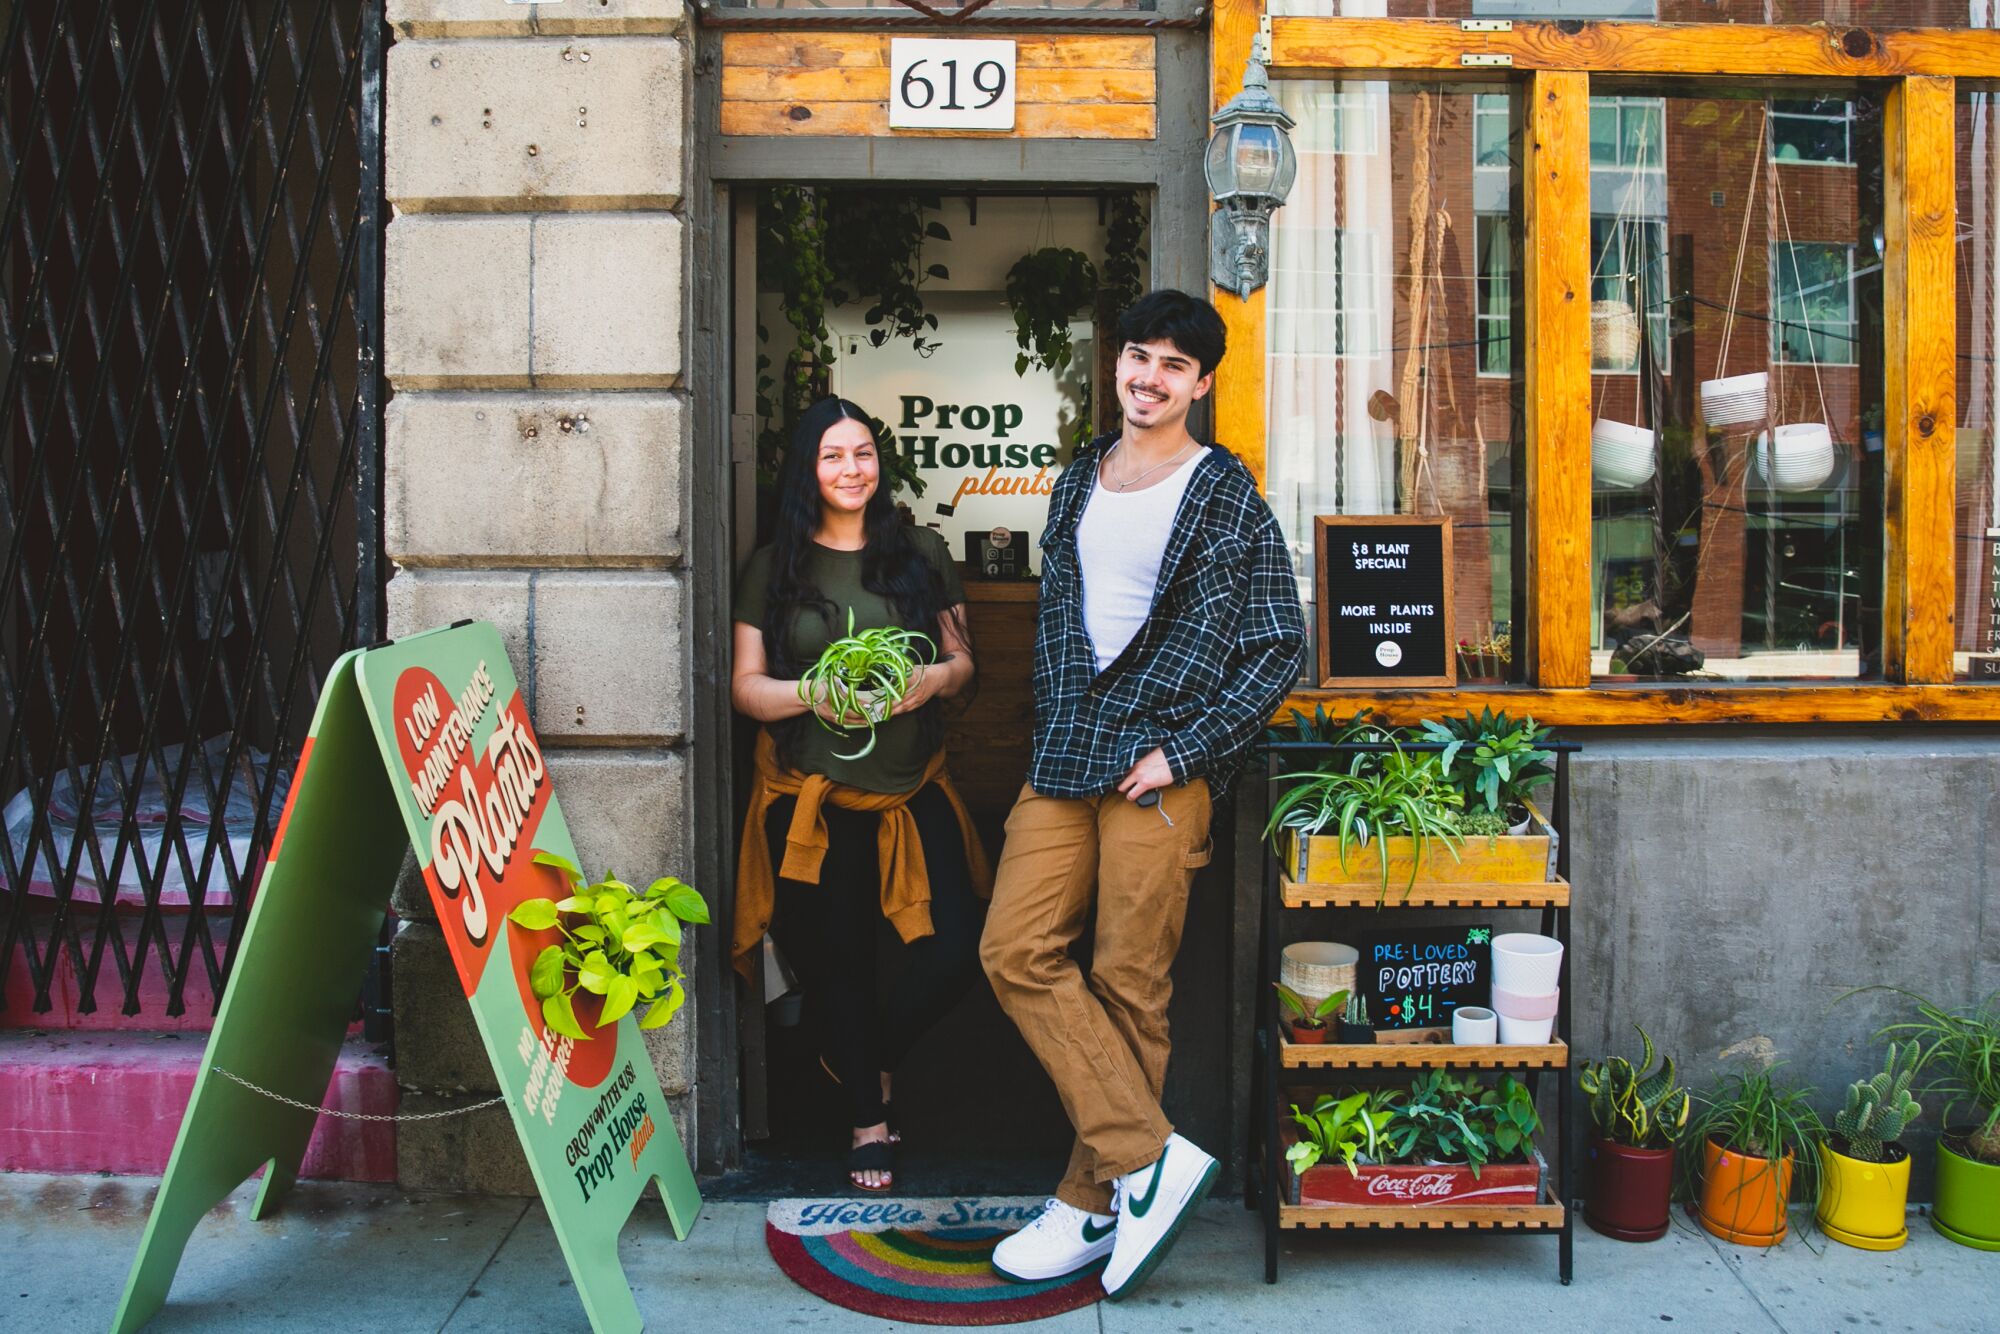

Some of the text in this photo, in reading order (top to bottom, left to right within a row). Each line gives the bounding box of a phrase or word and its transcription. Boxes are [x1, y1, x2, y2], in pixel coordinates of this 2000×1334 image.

[901, 59, 1006, 110] 619
[898, 395, 1023, 437] Prop
[898, 436, 1057, 469] House
[952, 464, 1053, 507] plants
[1352, 542, 1410, 557] $8 PLANT
[1355, 558, 1406, 569] SPECIAL!
[1341, 605, 1434, 616] MORE PLANTS
[1369, 623, 1412, 634] INSIDE
[405, 682, 440, 752] LOW
[411, 659, 495, 819] MAINTENANCE
[431, 699, 544, 941] Plants
[1379, 960, 1476, 993] POTTERY
[1401, 994, 1432, 1023] $4
[517, 1027, 535, 1066] NO
[565, 1060, 636, 1167] GROW WITH US!
[574, 1092, 648, 1204] Prop House
[629, 1112, 655, 1173] plants
[1367, 1173, 1458, 1196] Coca-Cola
[798, 1201, 926, 1226] Hello
